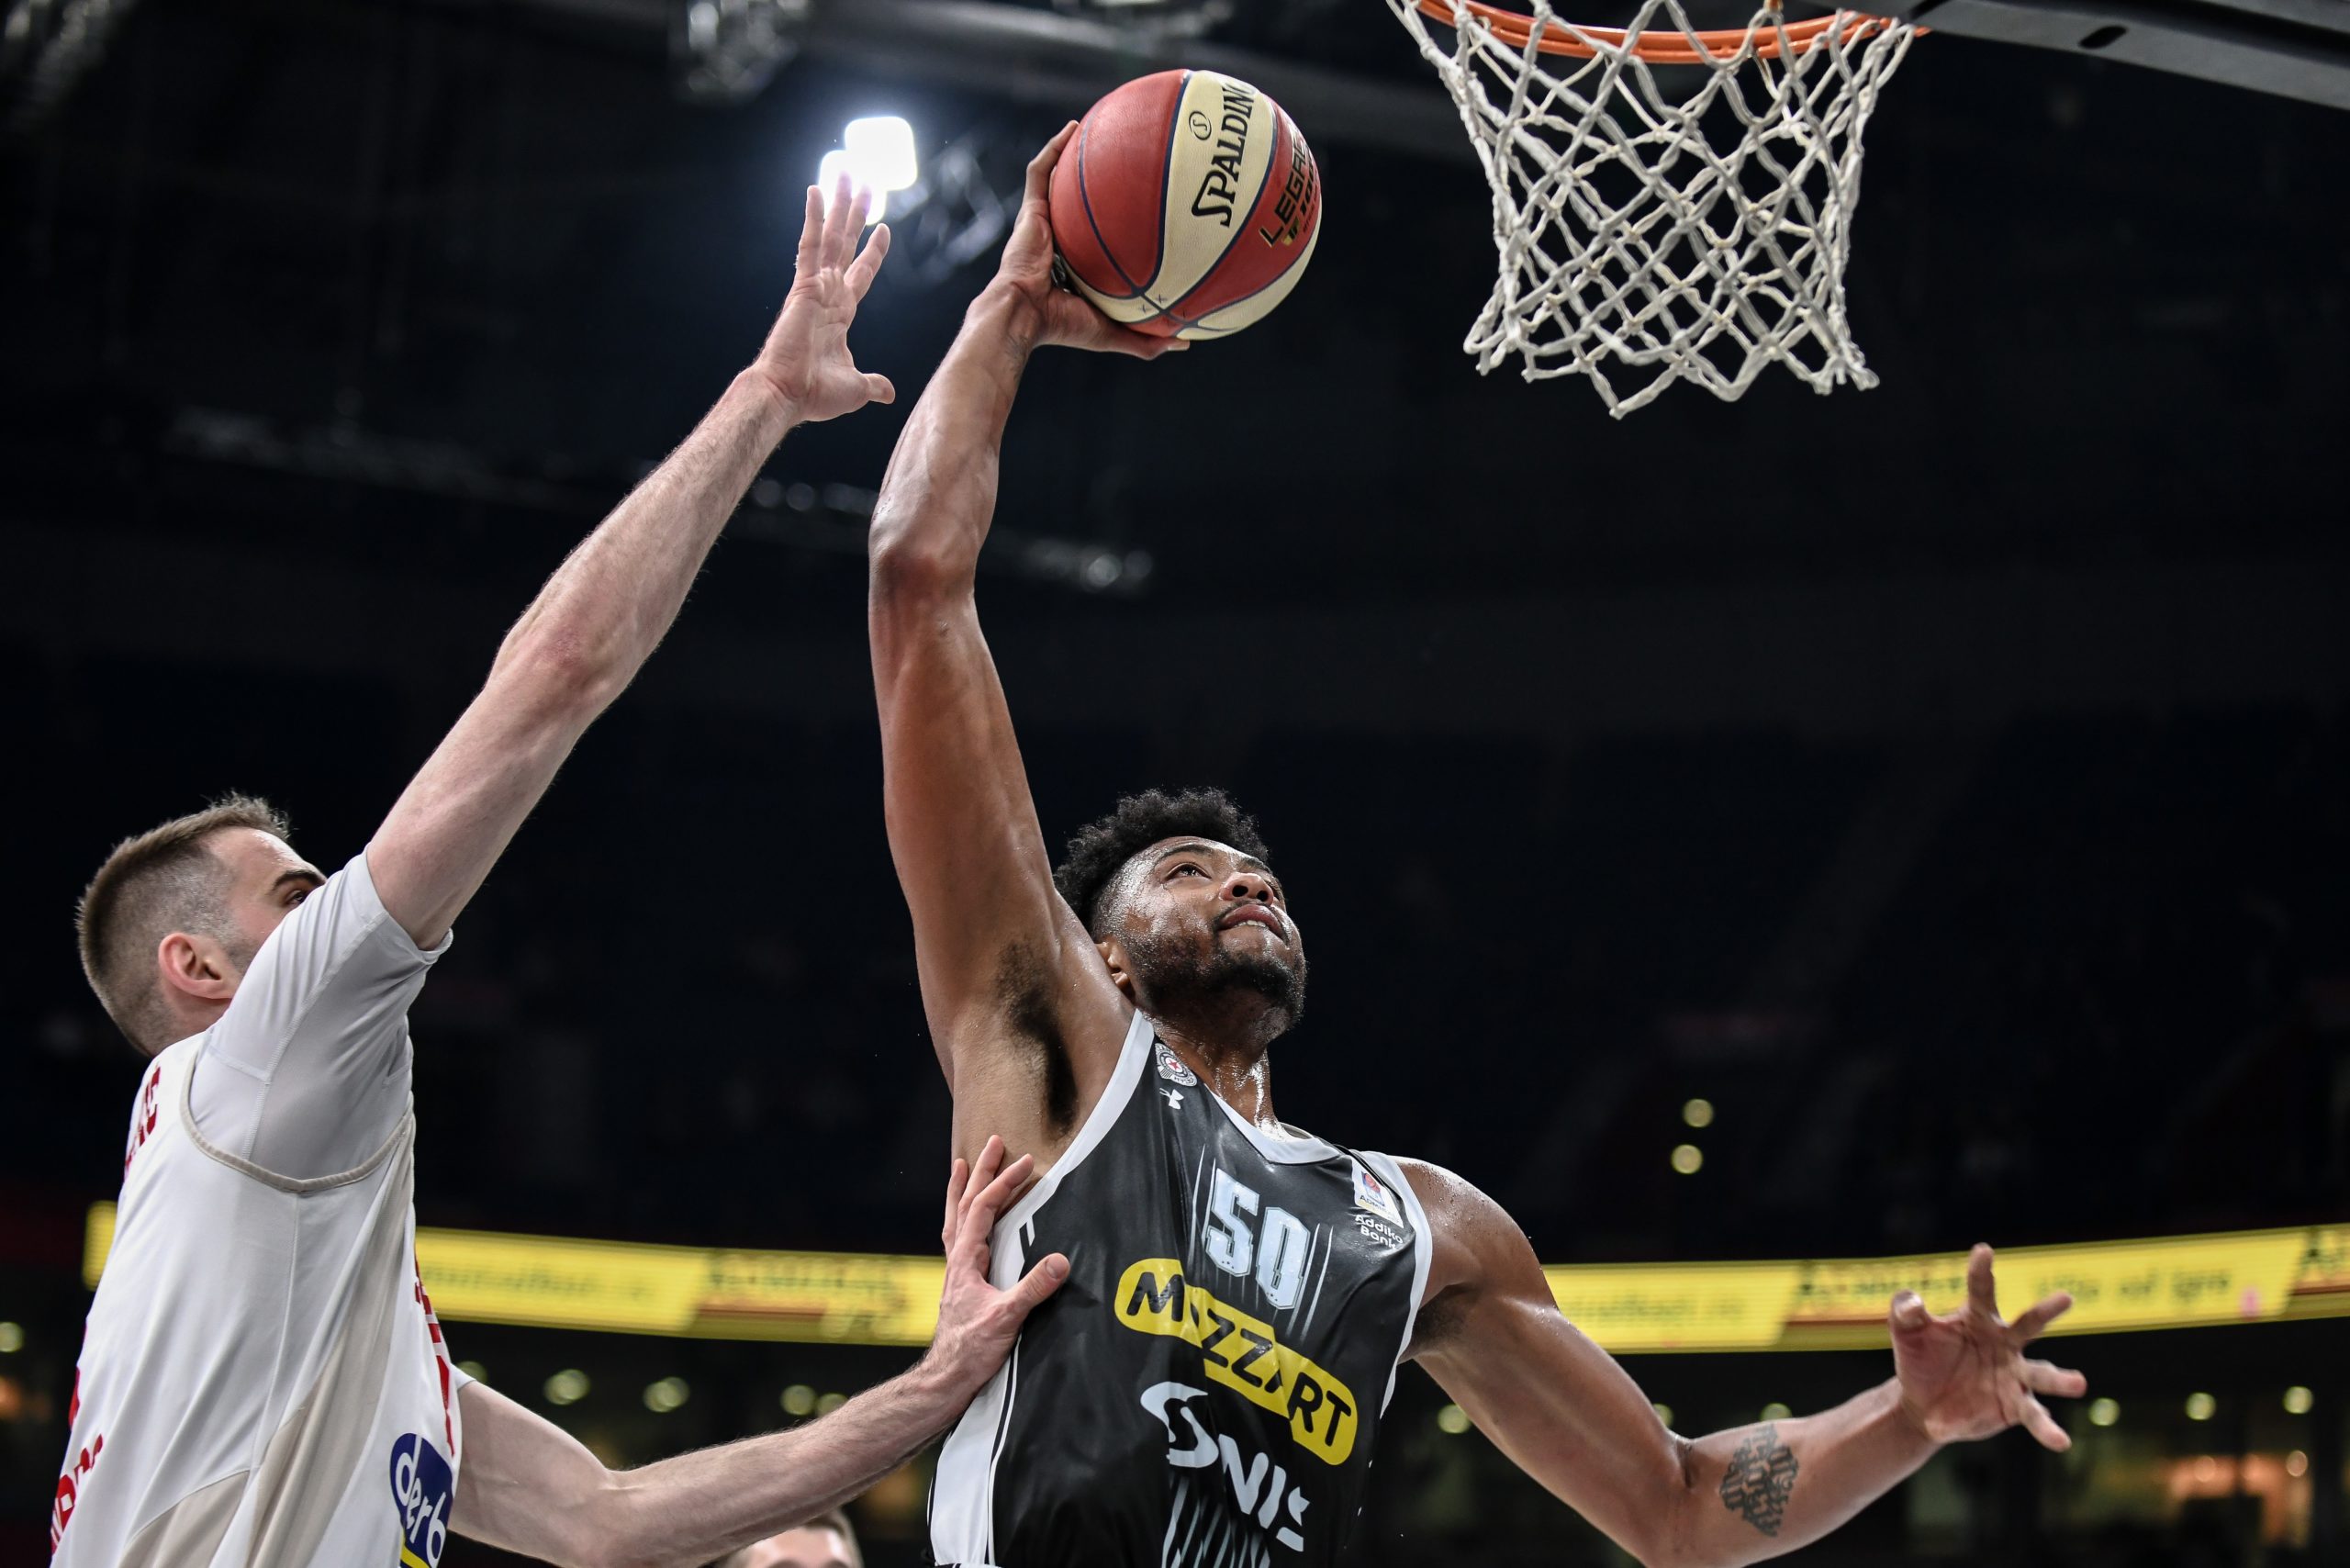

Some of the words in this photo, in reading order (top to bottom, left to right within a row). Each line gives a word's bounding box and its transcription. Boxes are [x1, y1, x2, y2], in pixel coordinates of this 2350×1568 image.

[1203, 1168, 1311, 1310] 50
[1355, 1214, 1404, 1243] Addiko
[1360, 1226, 1397, 1249] Bank
[1126, 1271, 1353, 1448] MZZRT
